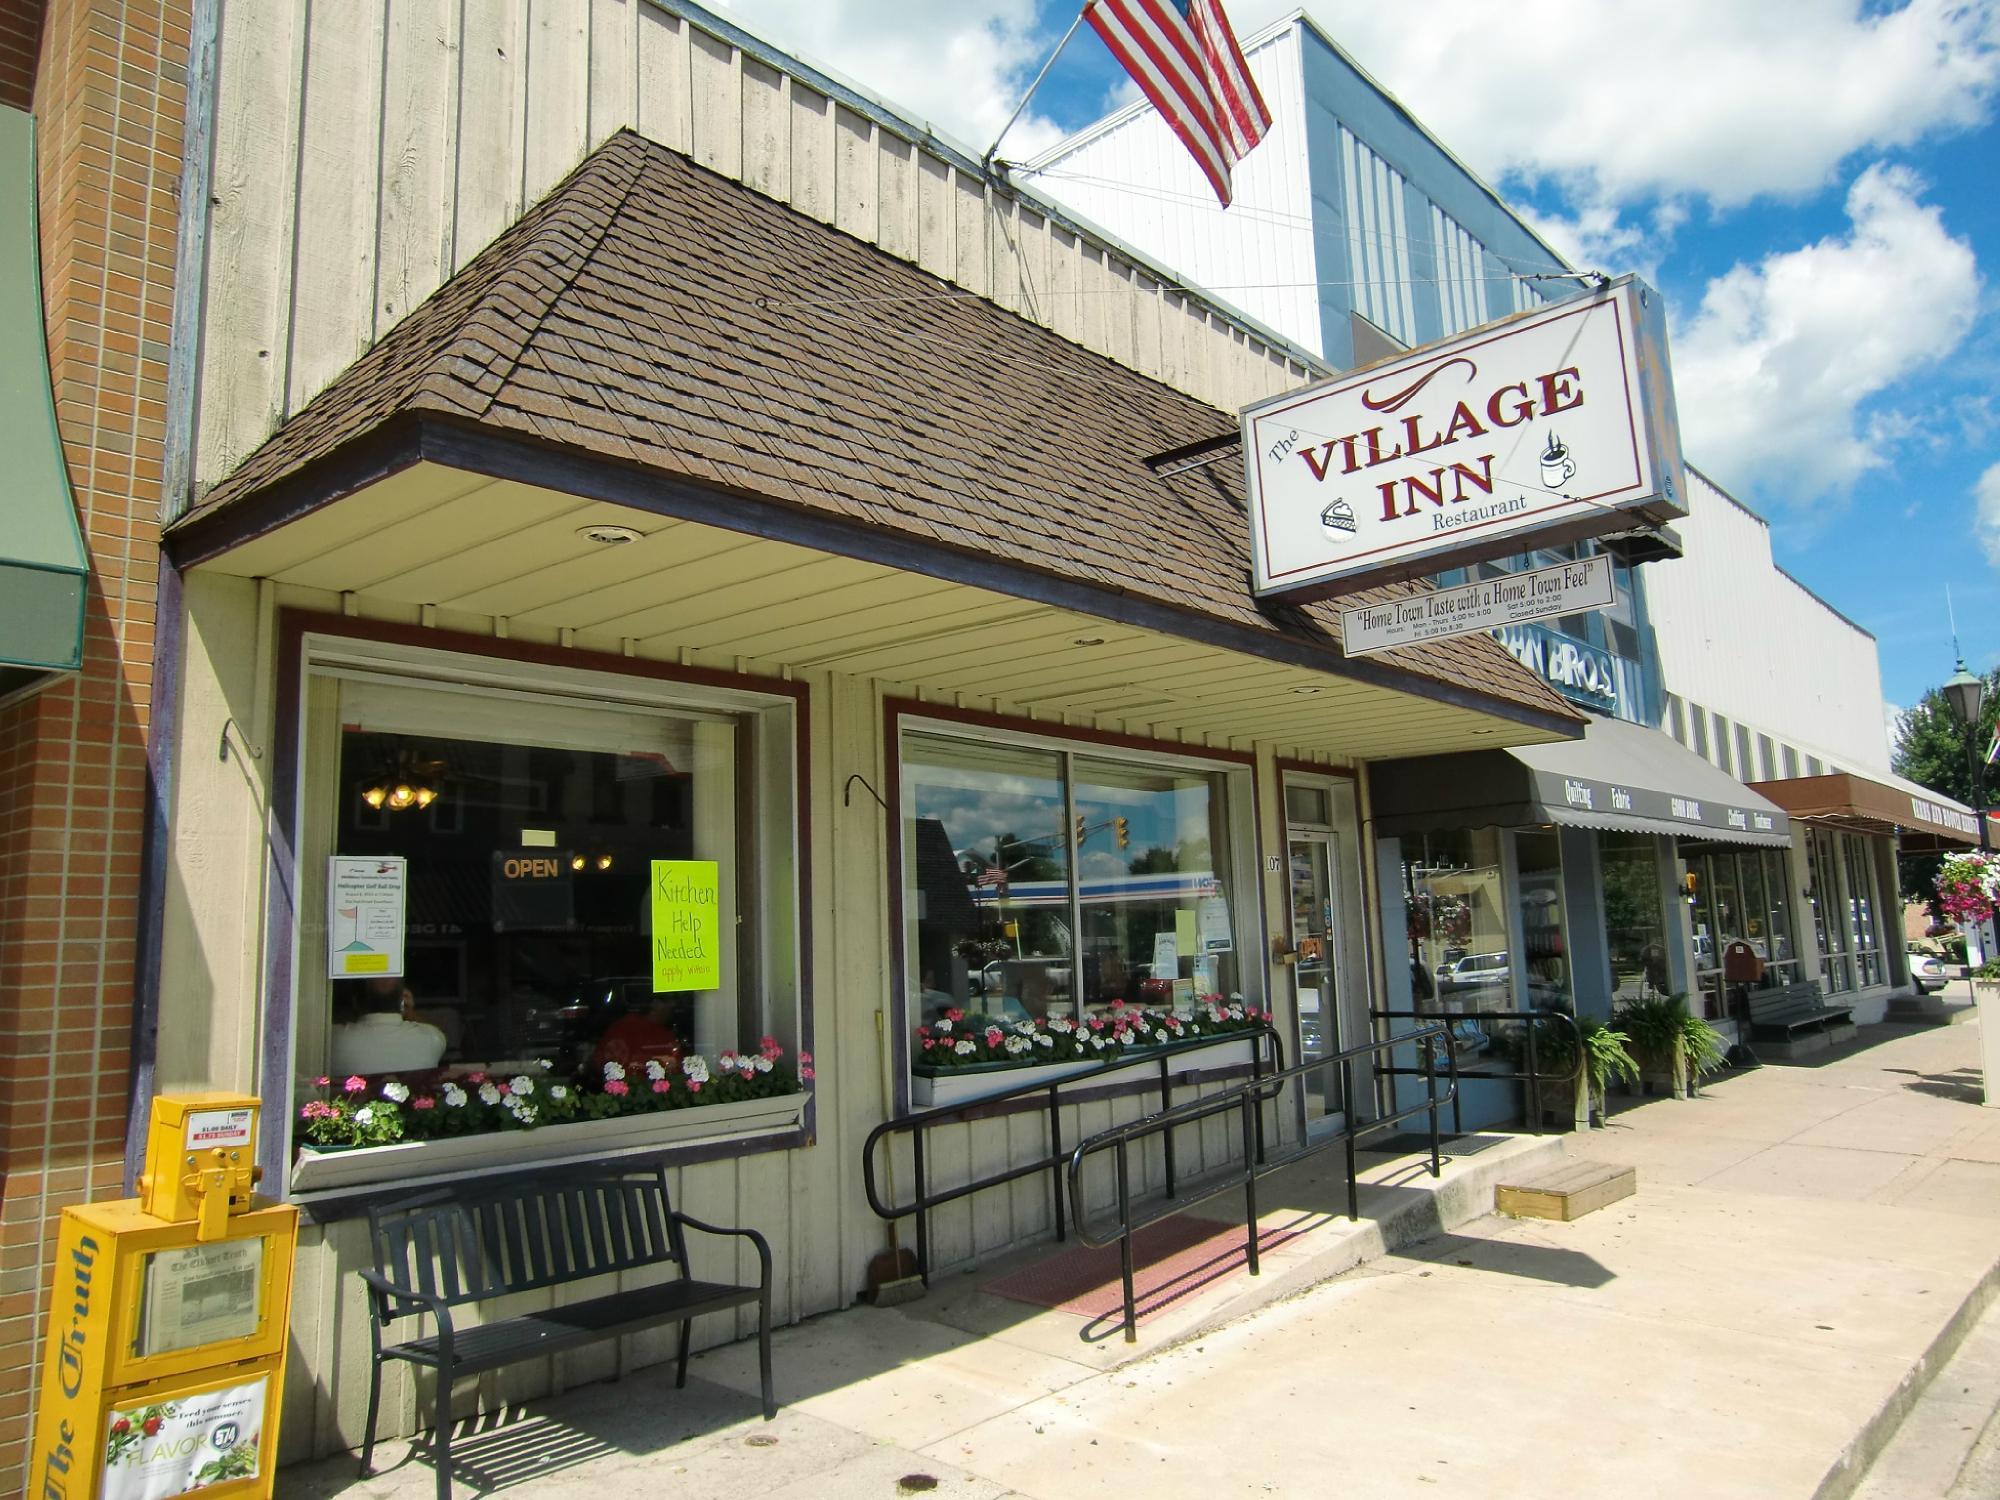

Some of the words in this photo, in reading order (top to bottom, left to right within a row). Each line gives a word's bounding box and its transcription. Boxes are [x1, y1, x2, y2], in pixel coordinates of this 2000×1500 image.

[1296, 366, 1584, 483] VILLAGE
[1268, 429, 1300, 464] The
[1376, 454, 1496, 522] INN
[1433, 494, 1528, 530] Restaurant
[1395, 603, 1423, 624] Town
[1426, 597, 1455, 617] Taste
[1457, 587, 1481, 608] with
[1483, 592, 1490, 606] a
[1494, 583, 1526, 604] Home
[1529, 575, 1561, 596] Town
[1509, 608, 1534, 619] Closed
[1535, 603, 1562, 614] Sunday
[1537, 597, 1544, 605] to
[1412, 622, 1427, 630] Mon
[1565, 779, 1592, 809] Quilting
[1611, 788, 1632, 810] Fabric
[504, 859, 559, 879] OPEN
[657, 865, 717, 905] Kitchen
[672, 911, 702, 943] Help
[657, 938, 706, 962] Needed
[661, 965, 683, 984] apply
[59, 1235, 99, 1399] Truth
[178, 1409, 201, 1420] Feed
[202, 1405, 221, 1417] your
[186, 1420, 204, 1429] this
[215, 1426, 236, 1445] 574
[127, 1433, 208, 1469] FLAVOR
